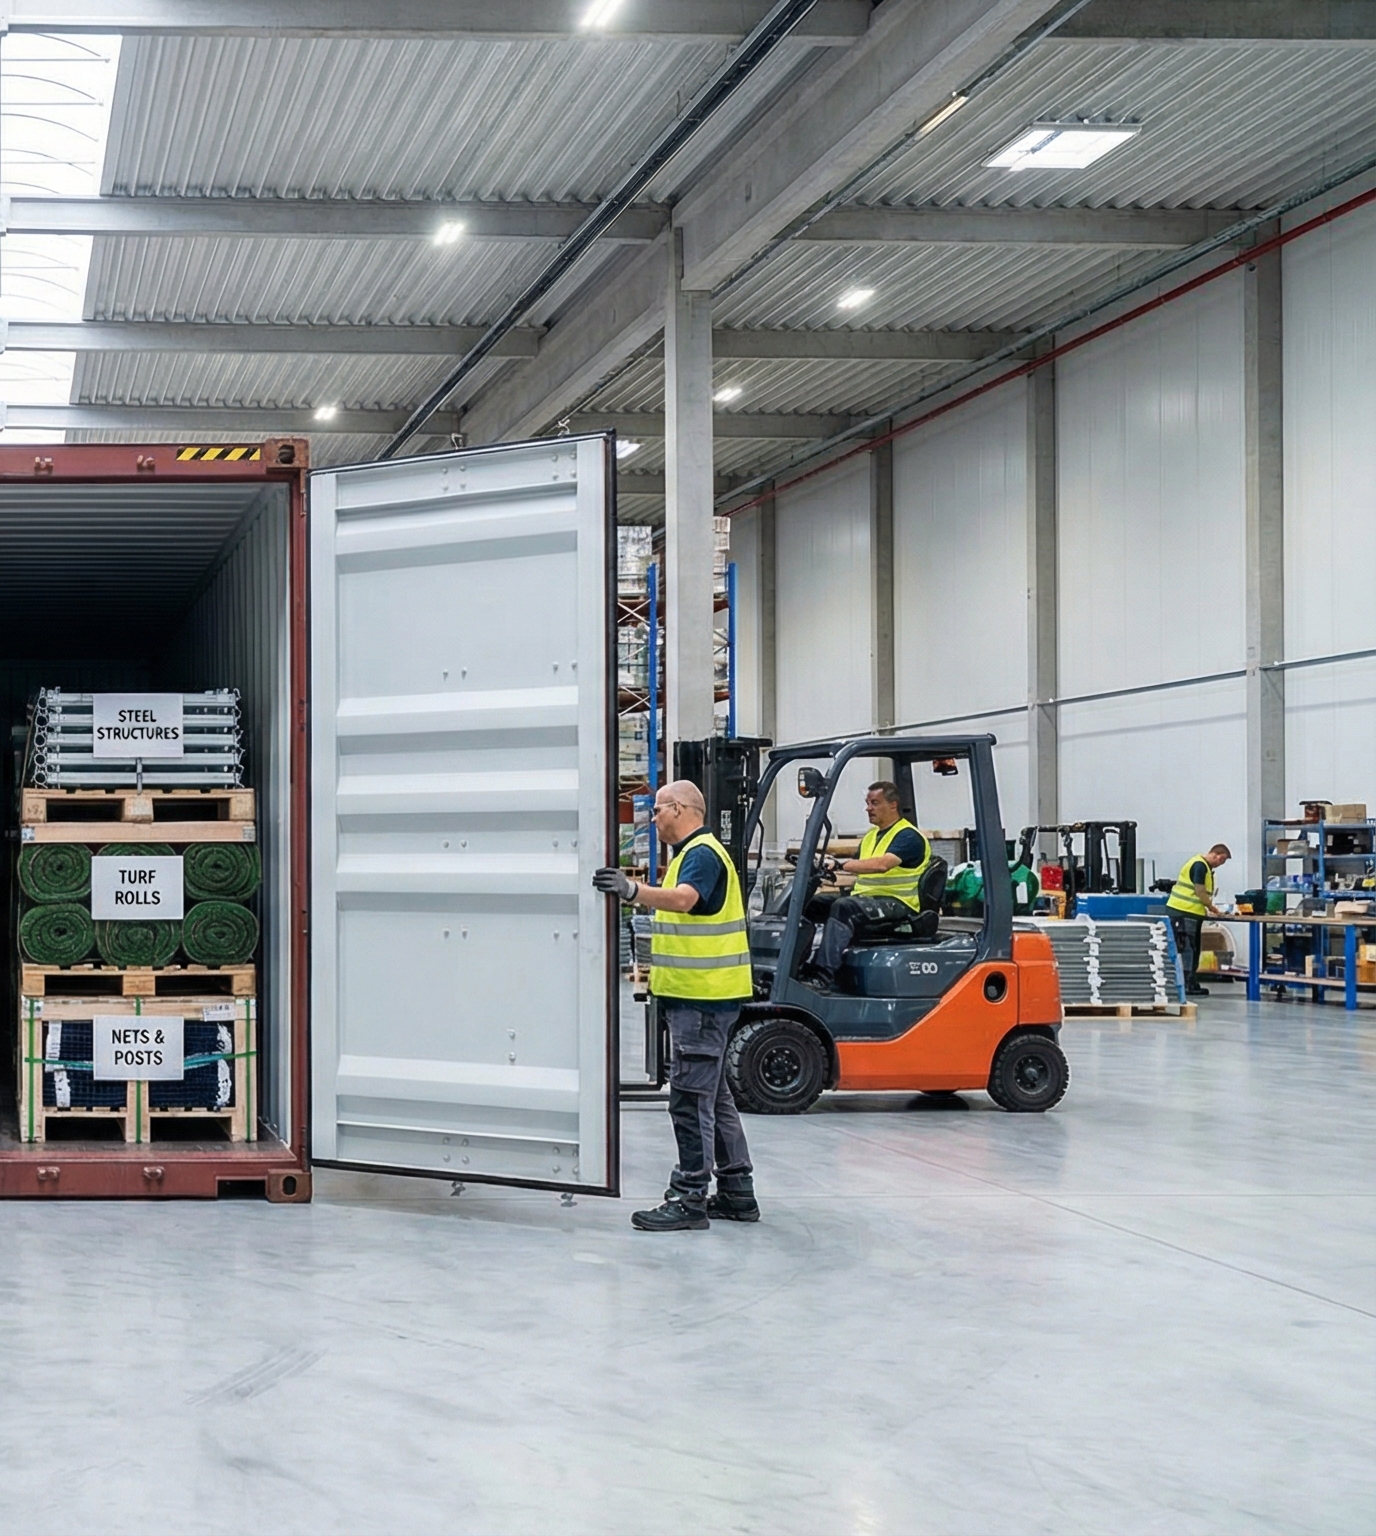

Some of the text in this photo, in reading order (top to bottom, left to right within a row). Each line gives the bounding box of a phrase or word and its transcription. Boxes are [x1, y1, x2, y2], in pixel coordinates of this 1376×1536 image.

[118, 709, 157, 723] STEEL
[96, 726, 180, 740] STRUCTURES
[118, 869, 157, 885] TURF
[115, 890, 161, 906] ROLLS
[111, 1029, 165, 1045] NETS &
[114, 1050, 163, 1066] POSTS
